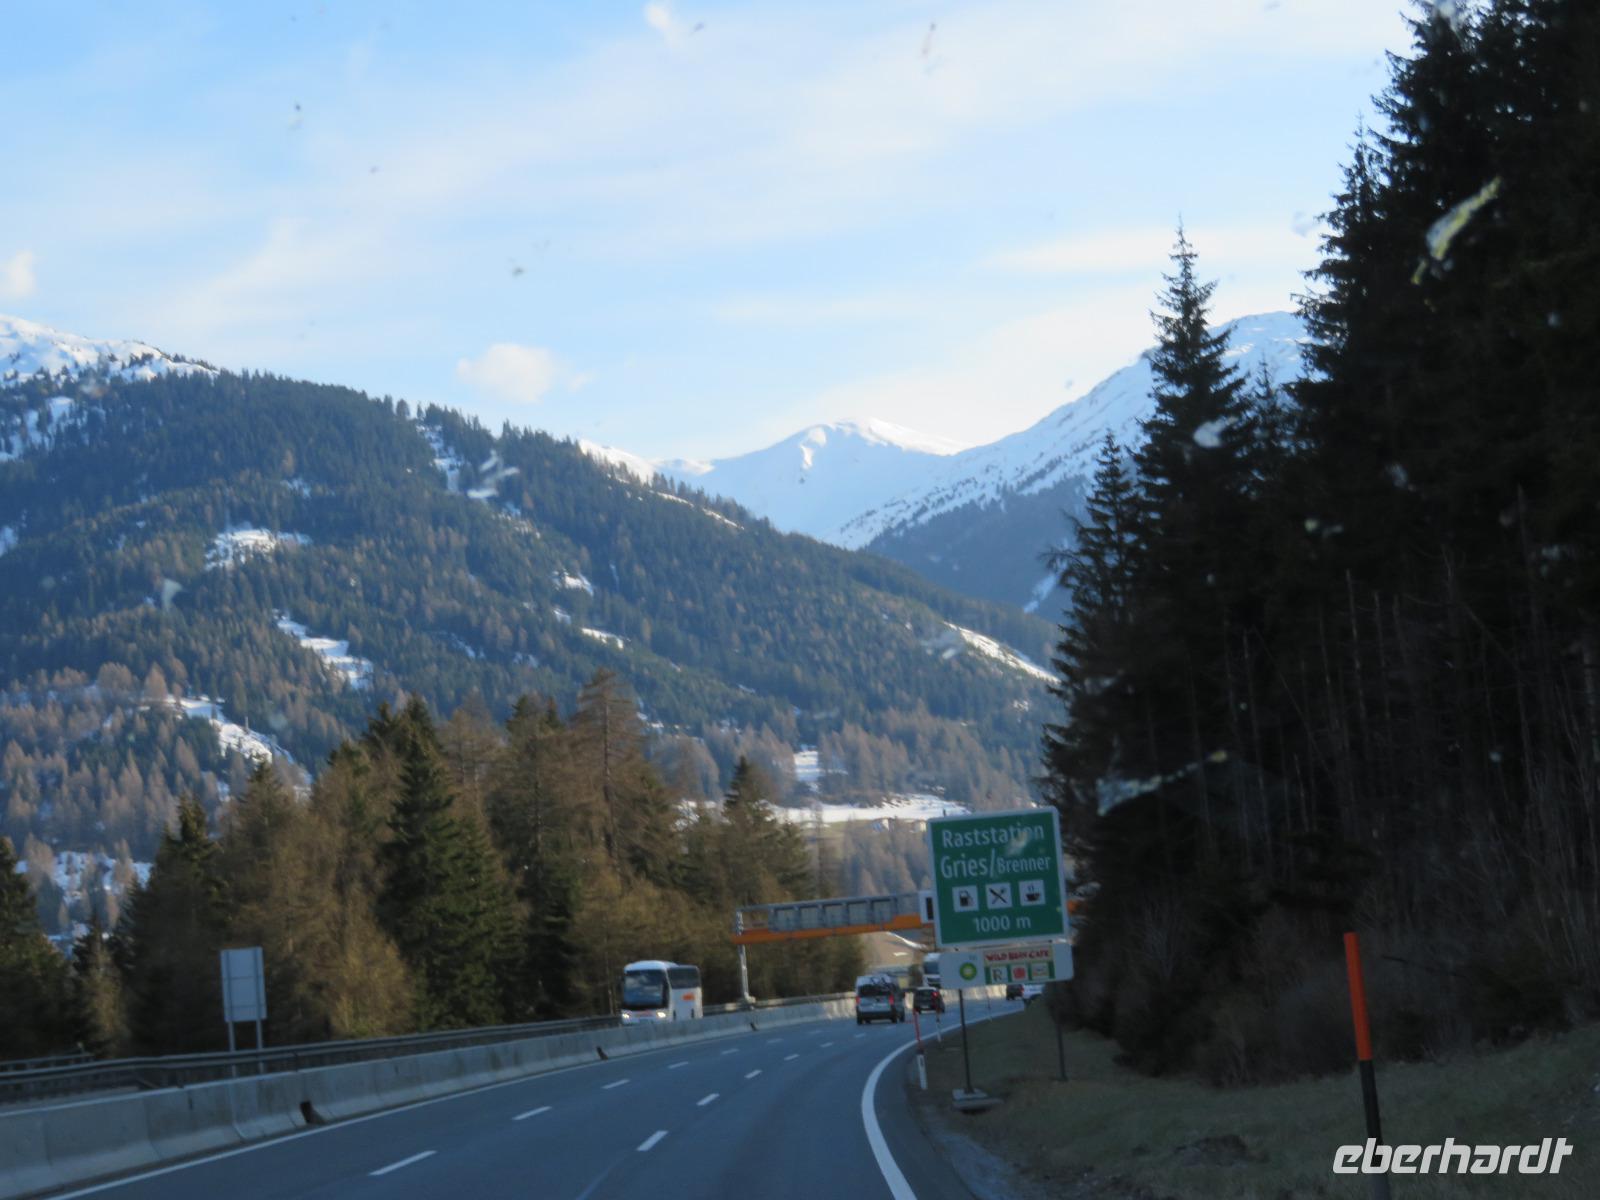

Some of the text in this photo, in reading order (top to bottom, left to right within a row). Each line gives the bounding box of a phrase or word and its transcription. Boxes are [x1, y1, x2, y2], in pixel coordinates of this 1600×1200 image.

[942, 822, 1044, 848] Raststation
[973, 916, 1031, 932] 1000 m
